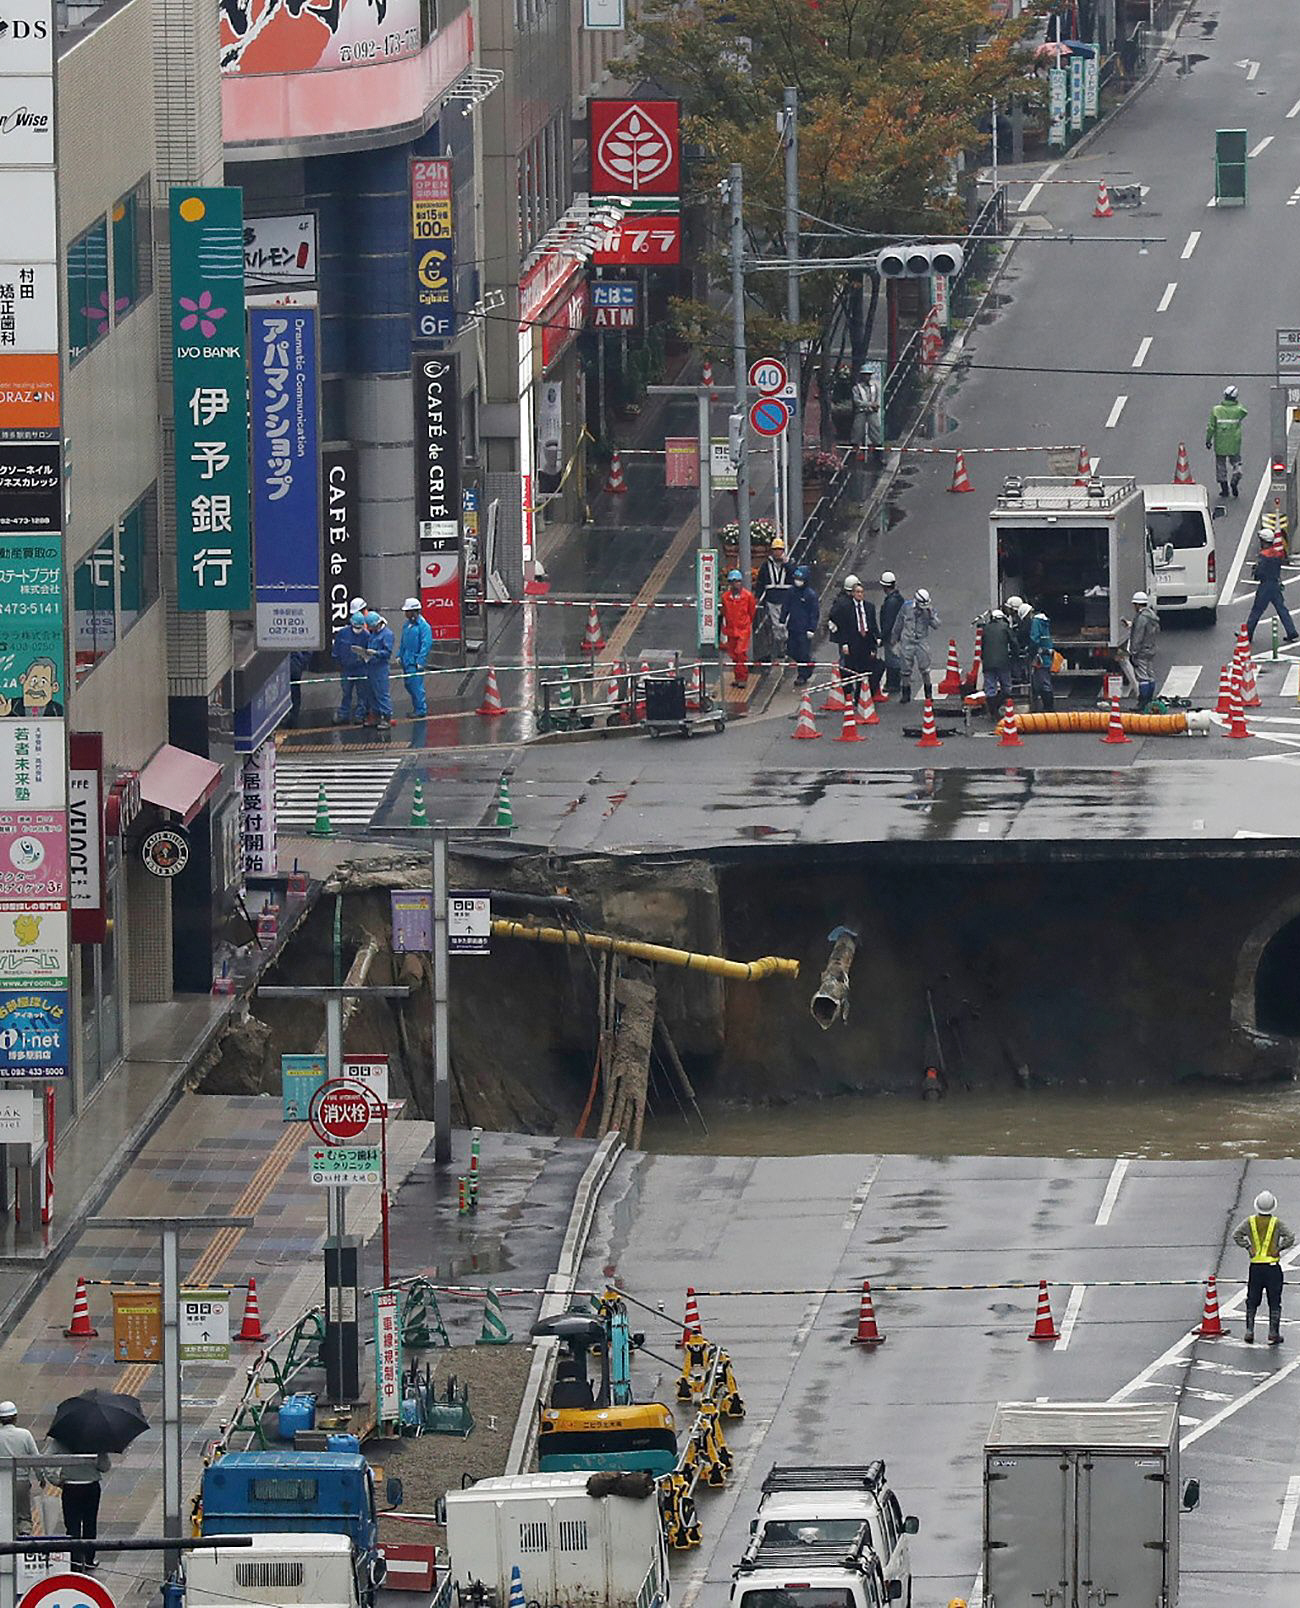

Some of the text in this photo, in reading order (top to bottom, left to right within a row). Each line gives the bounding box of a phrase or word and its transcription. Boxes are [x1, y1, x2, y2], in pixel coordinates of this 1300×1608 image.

[15, 112, 49, 127] Wise
[415, 162, 448, 180] 24h
[416, 222, 450, 237] 100円
[20, 268, 34, 299] 村田
[0, 283, 15, 346] 矯正歯科
[594, 308, 635, 327] ATM
[420, 315, 449, 335] 6F
[177, 347, 240, 358] IYO BANK
[295, 319, 307, 457] Dramatic Communication
[758, 370, 778, 388] 40
[263, 318, 293, 500] アパマンショップ
[427, 382, 448, 439] CAFÉ
[428, 443, 445, 460] de
[189, 388, 233, 587] 伊予銀行
[429, 465, 449, 518] CRIÉ
[329, 466, 350, 545] CAFÉ
[432, 540, 445, 550] 1F
[330, 552, 347, 575] de
[20, 584, 60, 595] 株式会社
[4, 603, 60, 614] 473-5141
[426, 598, 454, 608] アコム
[324, 1103, 367, 1124] 消火栓
[327, 1150, 378, 1161] むらつ歯科
